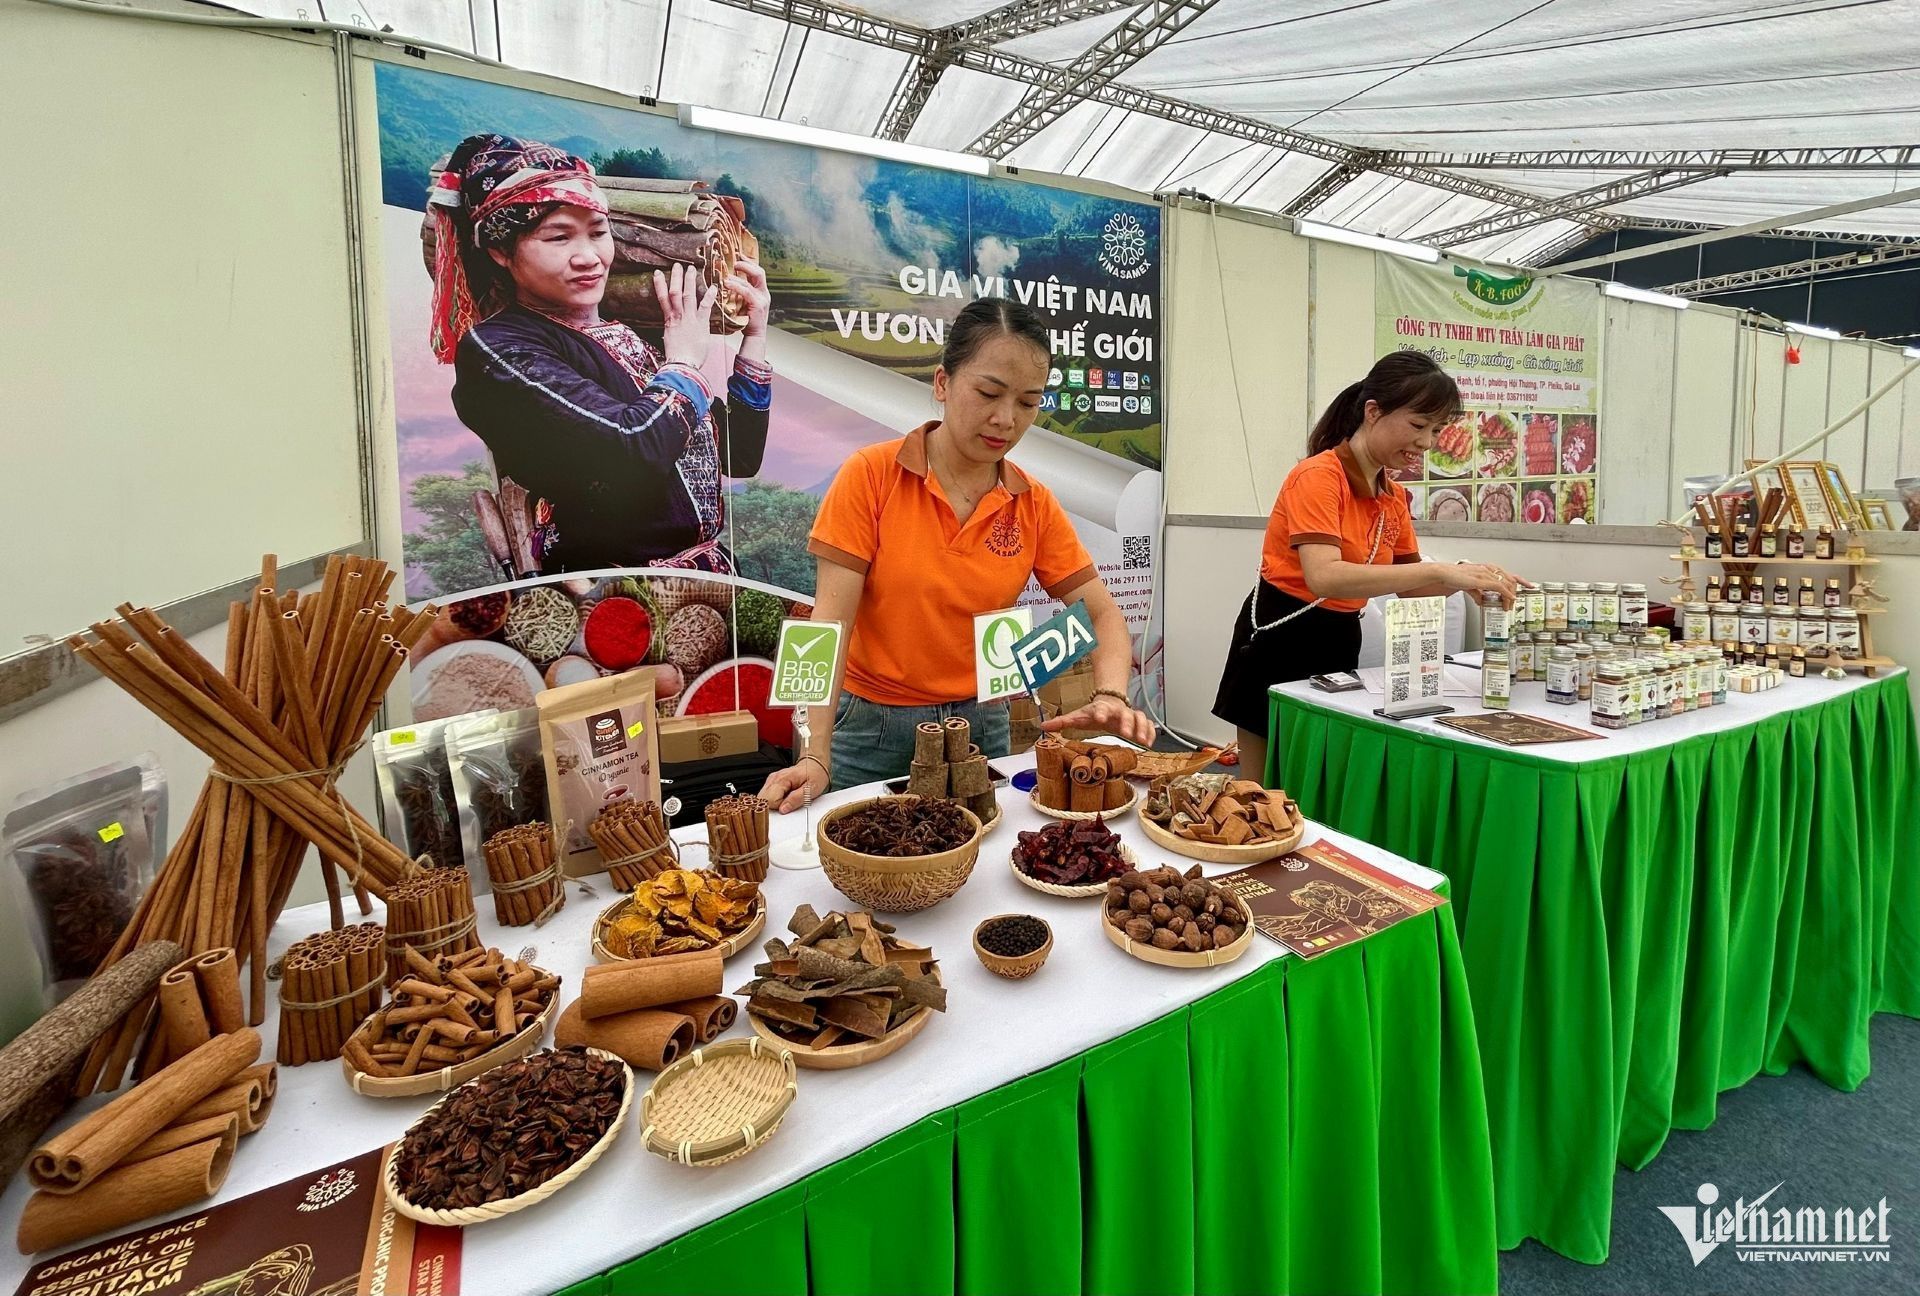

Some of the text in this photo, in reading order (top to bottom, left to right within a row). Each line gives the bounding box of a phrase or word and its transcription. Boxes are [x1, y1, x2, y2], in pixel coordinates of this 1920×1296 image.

[1098, 252, 1151, 280] VINASAMEX
[899, 265, 963, 298] GIA
[1013, 275, 1077, 316] VIỆT
[1085, 288, 1152, 320] NAM
[831, 308, 944, 345] VƯƠN
[1045, 320, 1153, 361] HẾ GIỚI
[1396, 315, 1425, 336] CÔNG
[1428, 321, 1442, 338] TY
[1445, 323, 1473, 341] TNHH
[1476, 326, 1496, 343] MTV
[1546, 334, 1560, 349] GIA
[1563, 334, 1584, 352] PHÁT
[1458, 349, 1479, 368] Lạp
[1110, 577, 1121, 585] 246
[1123, 575, 1135, 584] 297
[1137, 574, 1151, 582] 1111
[1017, 614, 1094, 685] FDA
[782, 660, 828, 678] BRC
[780, 677, 826, 692] FOOD
[989, 672, 1023, 695] BIO
[581, 752, 639, 776] CINNAMON TEA
[598, 766, 630, 782] Organic
[36, 1217, 209, 1280] ORGANIC SPICE
[379, 1212, 396, 1267] ORGANIC
[29, 1253, 154, 1296] ESSENTIAL
[160, 1236, 195, 1255] OIL
[416, 1259, 431, 1287] STAR
